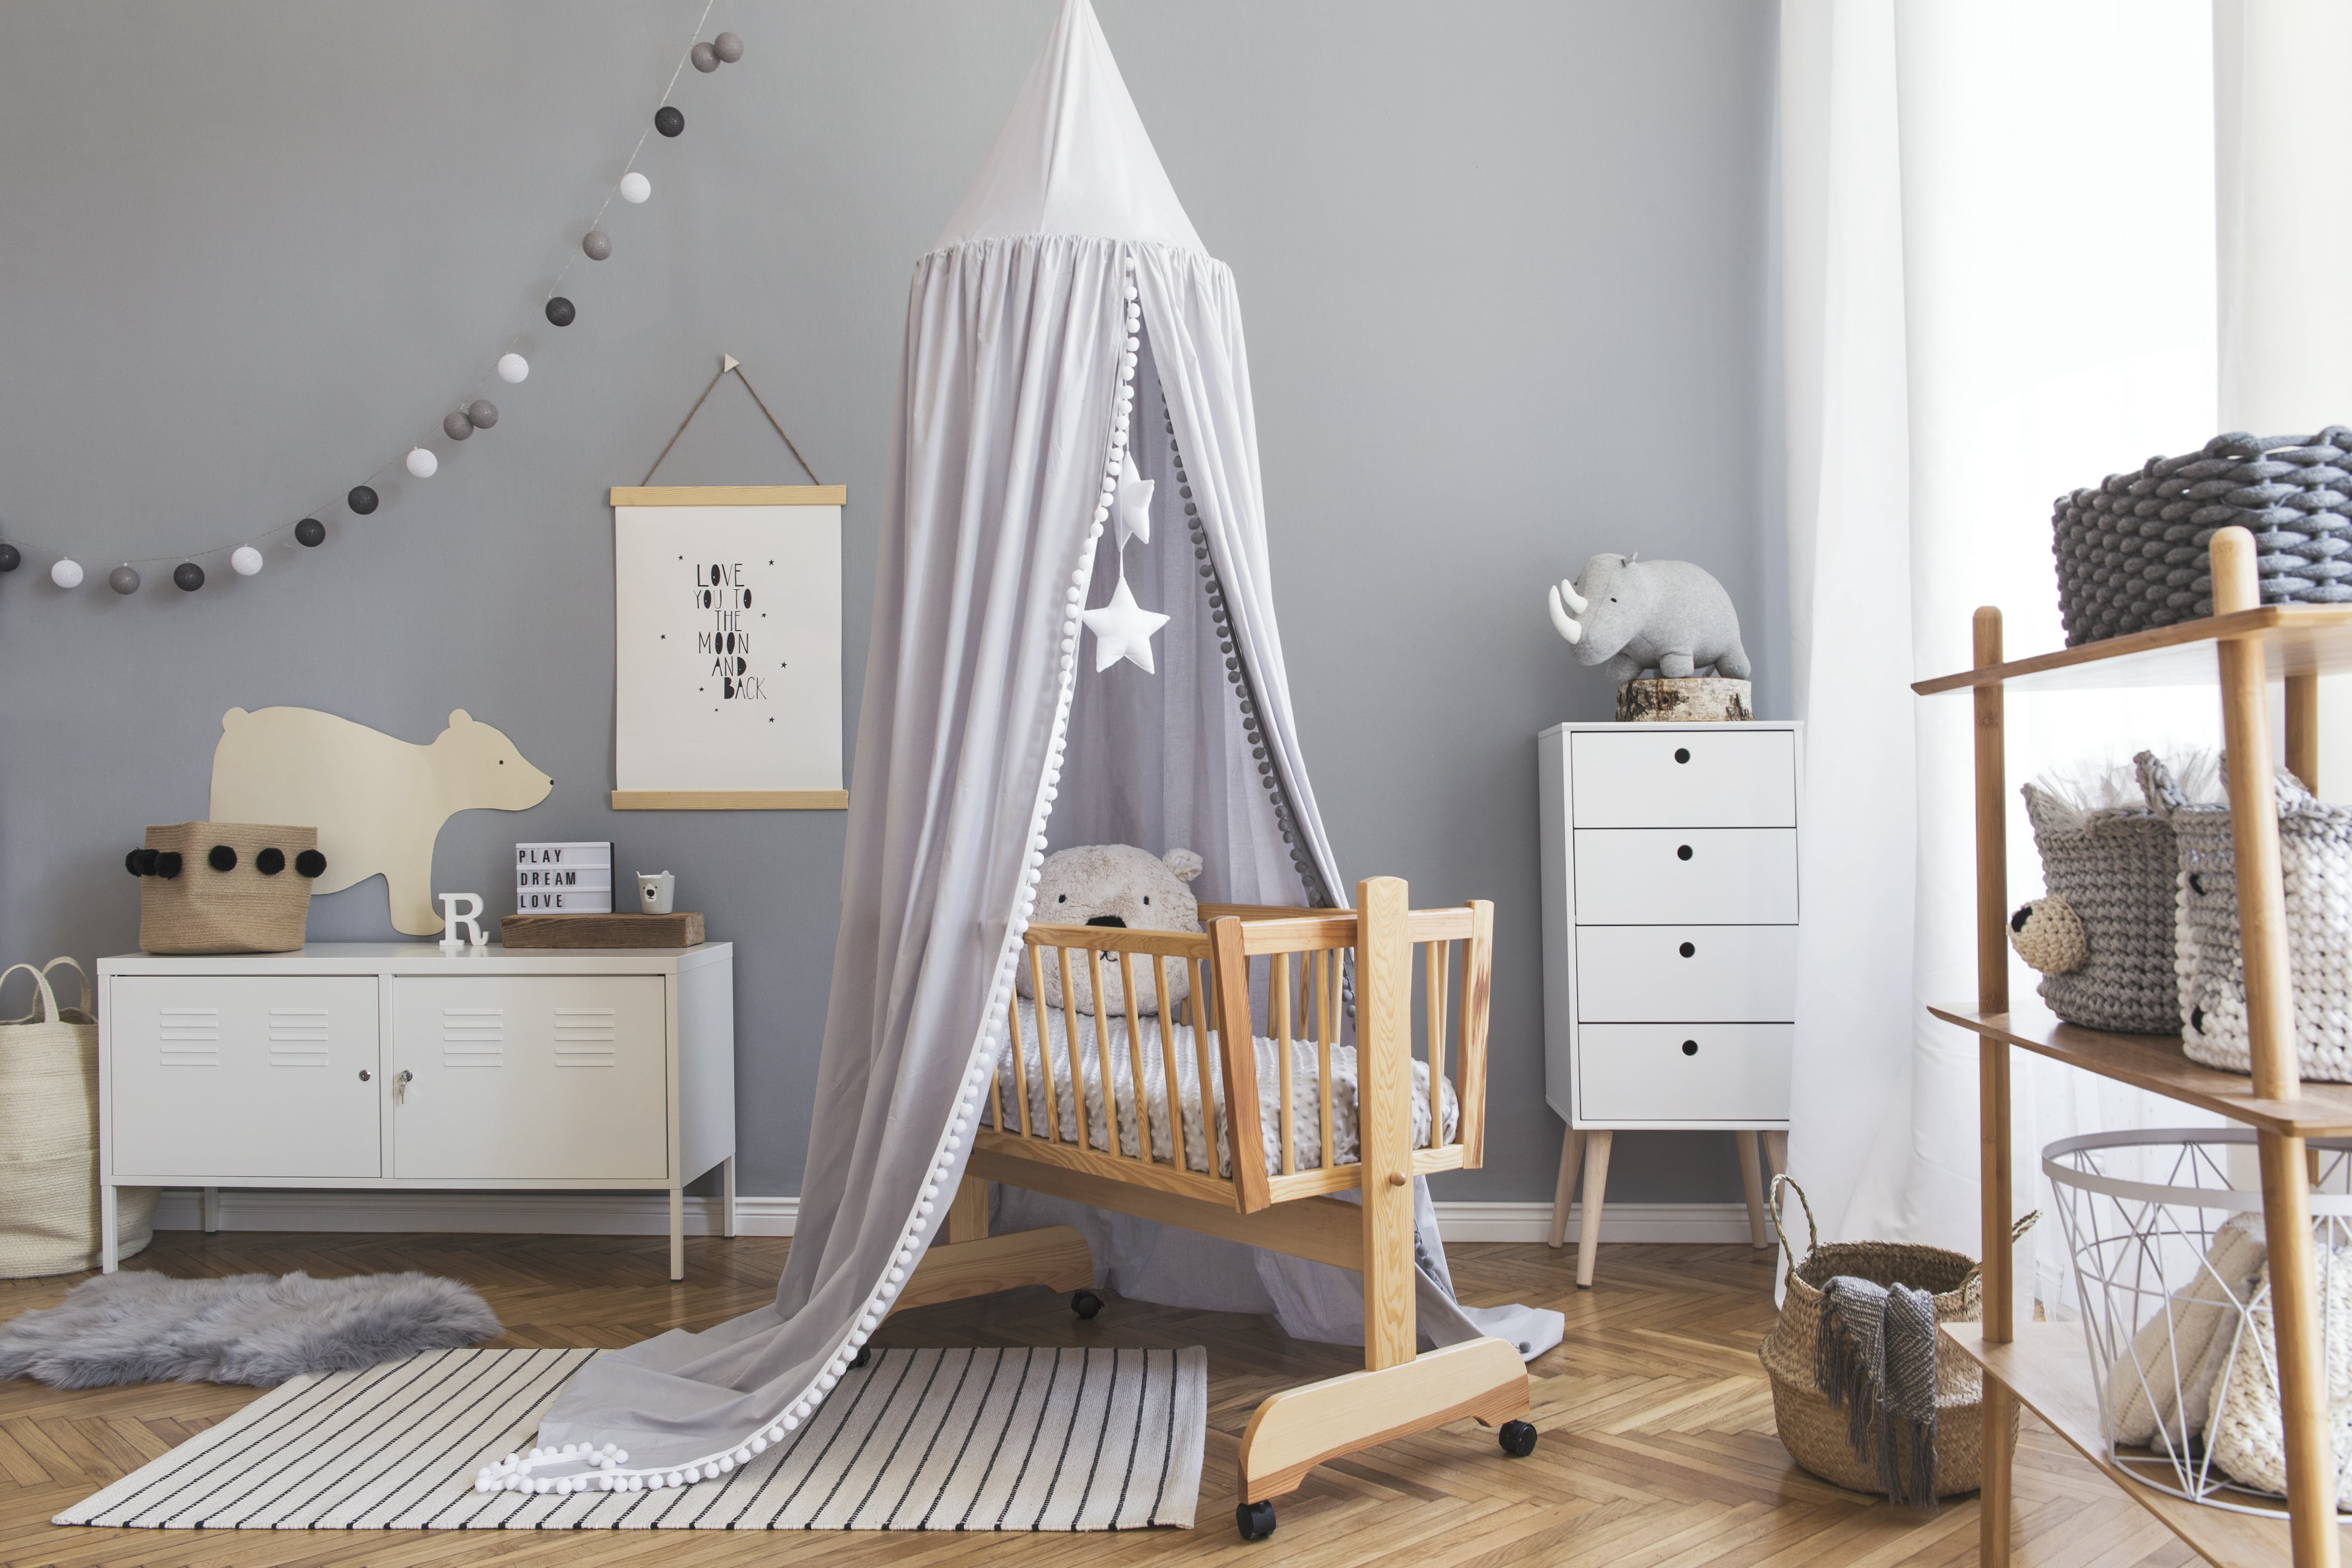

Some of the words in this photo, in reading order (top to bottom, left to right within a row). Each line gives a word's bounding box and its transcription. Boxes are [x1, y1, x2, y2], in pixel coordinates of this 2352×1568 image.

[697, 564, 745, 587] LOVE
[693, 589, 722, 609] YOU
[733, 588, 752, 609] TO
[715, 610, 742, 631] THE
[699, 631, 749, 655] MOON
[711, 656, 747, 677] AND
[723, 677, 767, 700] BACK
[519, 849, 562, 863] PLAY
[521, 872, 576, 886] DREAM
[520, 894, 563, 908] LOVE
[438, 893, 490, 946] R
